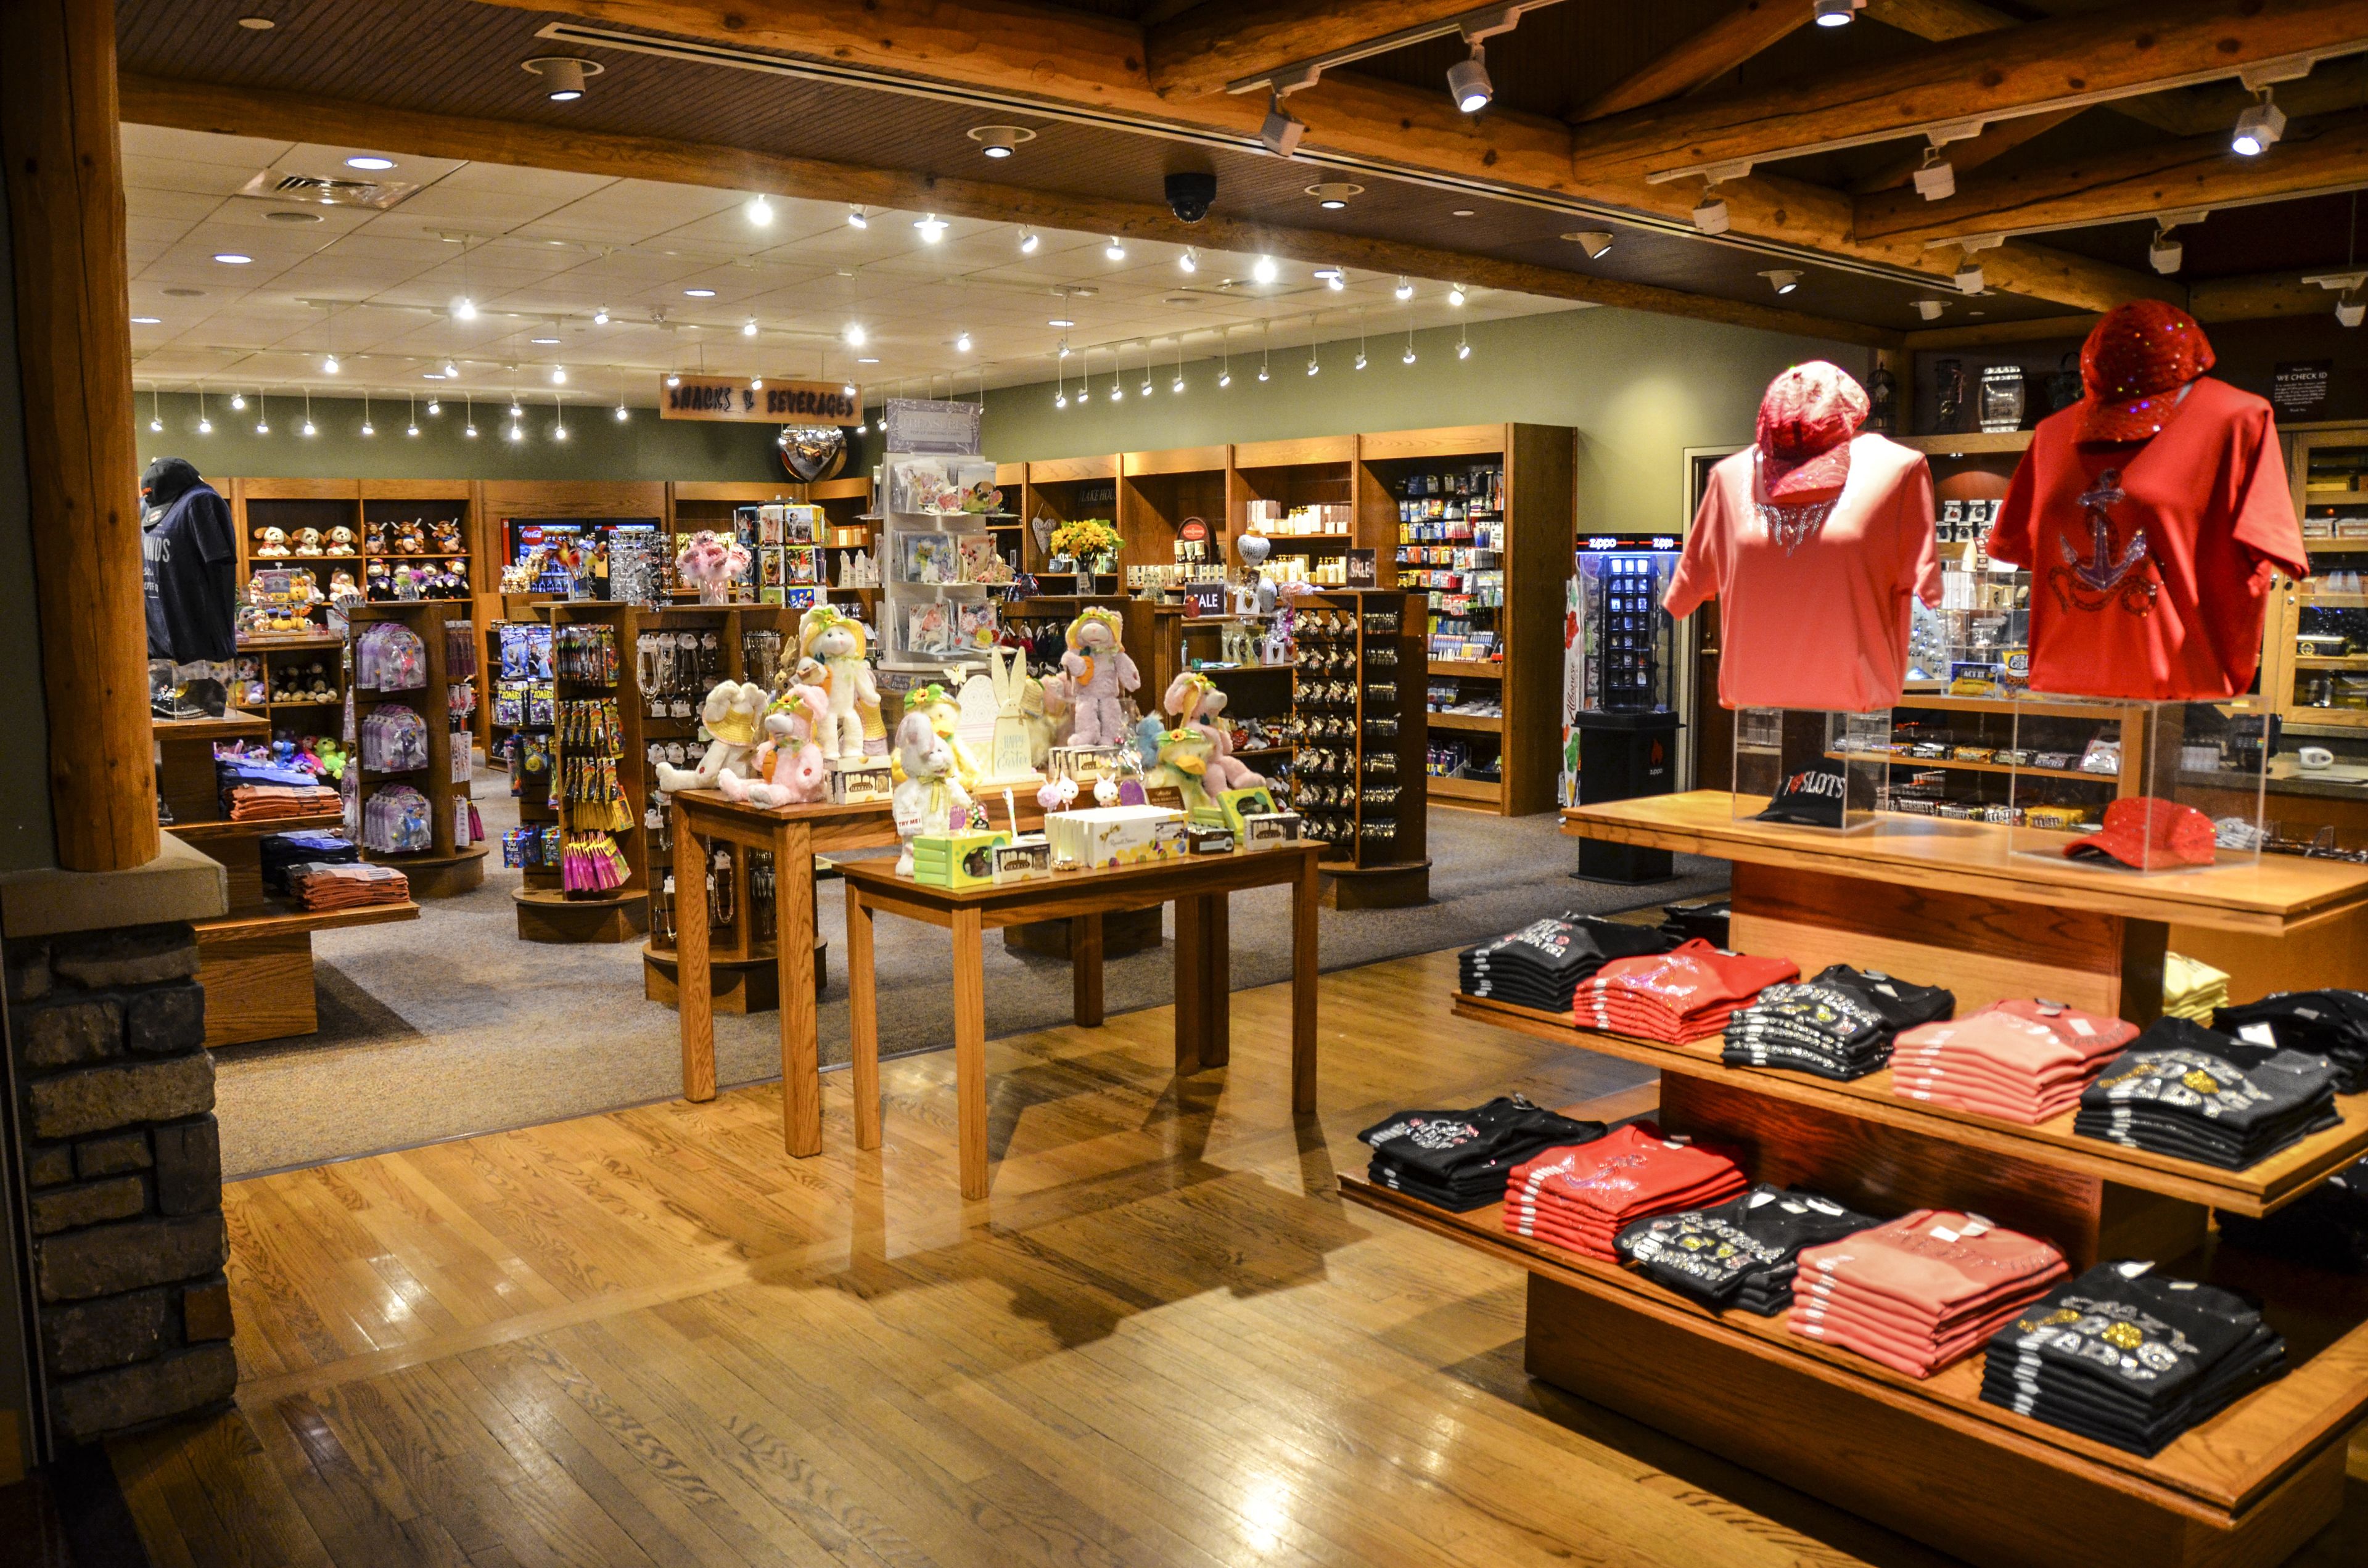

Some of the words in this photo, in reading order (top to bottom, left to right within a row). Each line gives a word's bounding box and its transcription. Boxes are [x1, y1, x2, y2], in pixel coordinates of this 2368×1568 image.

[2290, 372, 2317, 381] CHECK
[670, 385, 731, 411] SNACKS
[742, 389, 755, 409] &
[767, 389, 854, 418] BEVERAGES
[1100, 487, 1117, 501] HOU
[522, 530, 542, 540] Coca-Cola
[1589, 537, 1618, 550] zippo
[1350, 561, 1370, 578] SALE
[1194, 594, 1219, 608] ALE
[1003, 734, 1024, 749] HAPPY
[997, 750, 1030, 771] Easter
[1800, 771, 1846, 799] SLOTS
[1900, 799, 1935, 815] HERSHEY'S
[898, 819, 909, 827] TRY
[2060, 1295, 2200, 1355] CRAZY
